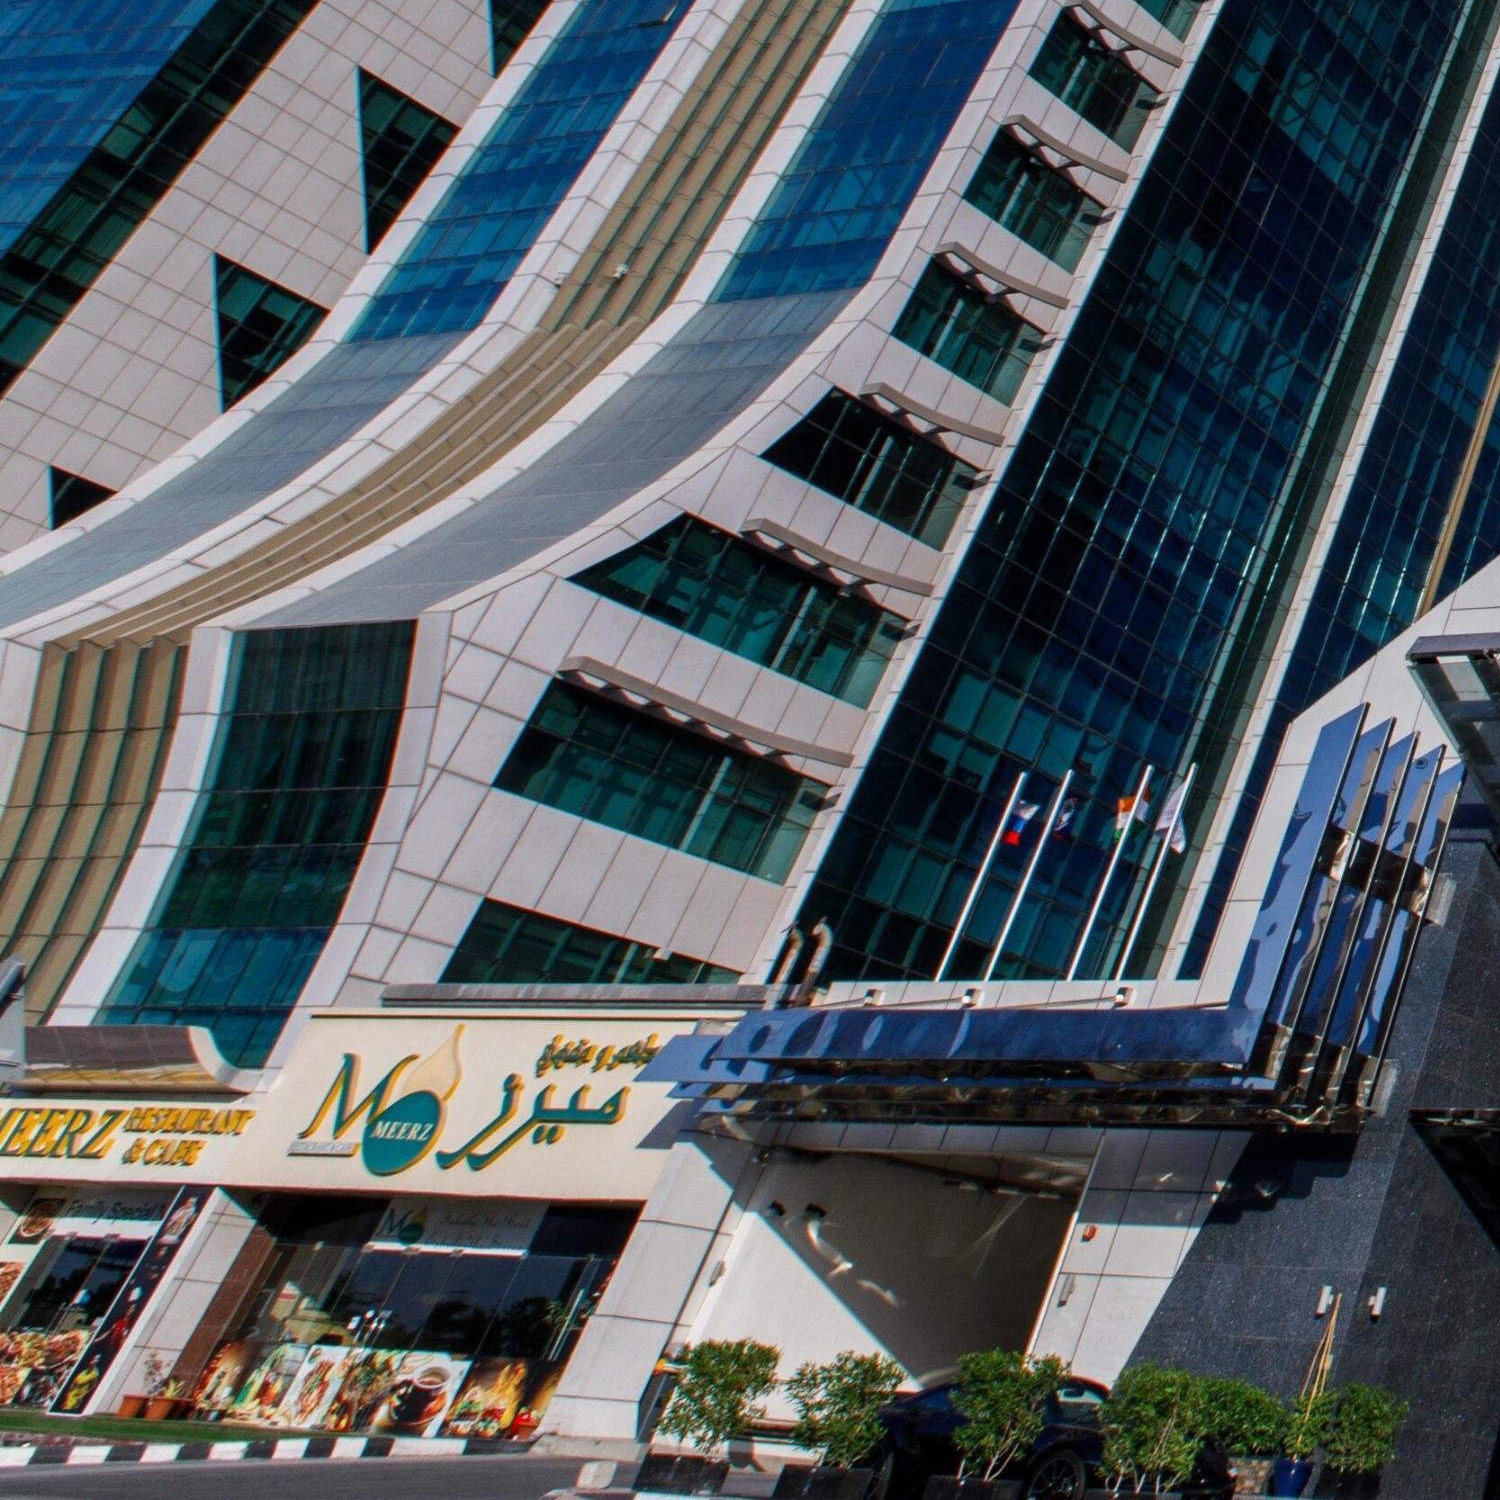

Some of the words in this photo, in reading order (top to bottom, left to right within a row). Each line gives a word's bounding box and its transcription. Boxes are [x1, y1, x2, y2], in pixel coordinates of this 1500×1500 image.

[122, 1107, 257, 1135] RESTAURANT
[370, 1120, 435, 1142] MEERZ
[122, 1138, 142, 1165] &
[143, 1138, 208, 1166] CAFE
